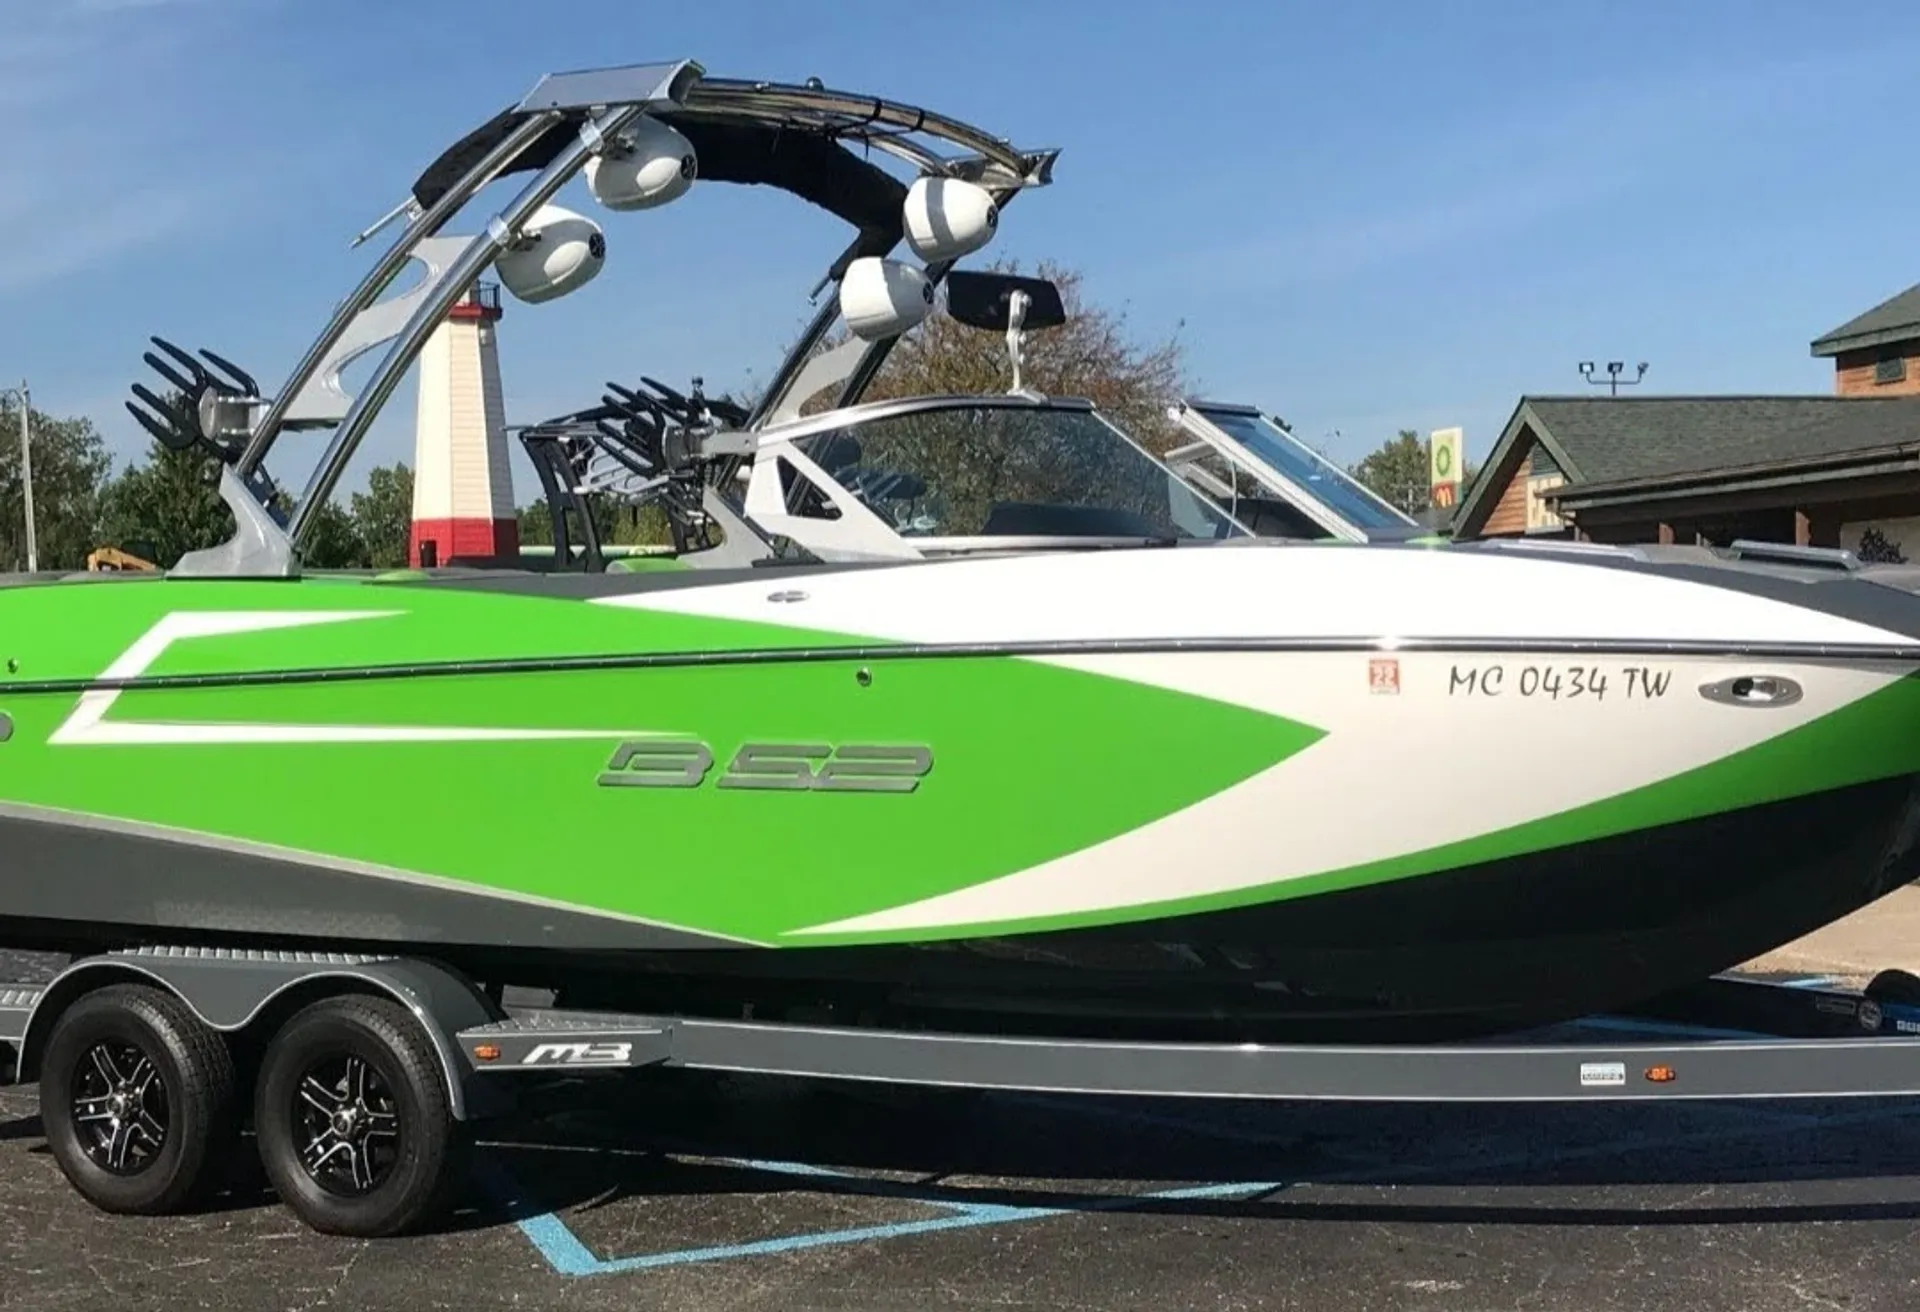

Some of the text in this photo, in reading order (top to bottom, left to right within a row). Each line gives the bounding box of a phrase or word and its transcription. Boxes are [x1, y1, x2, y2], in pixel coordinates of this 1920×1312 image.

[1449, 665, 1672, 702] MC 0434 TW
